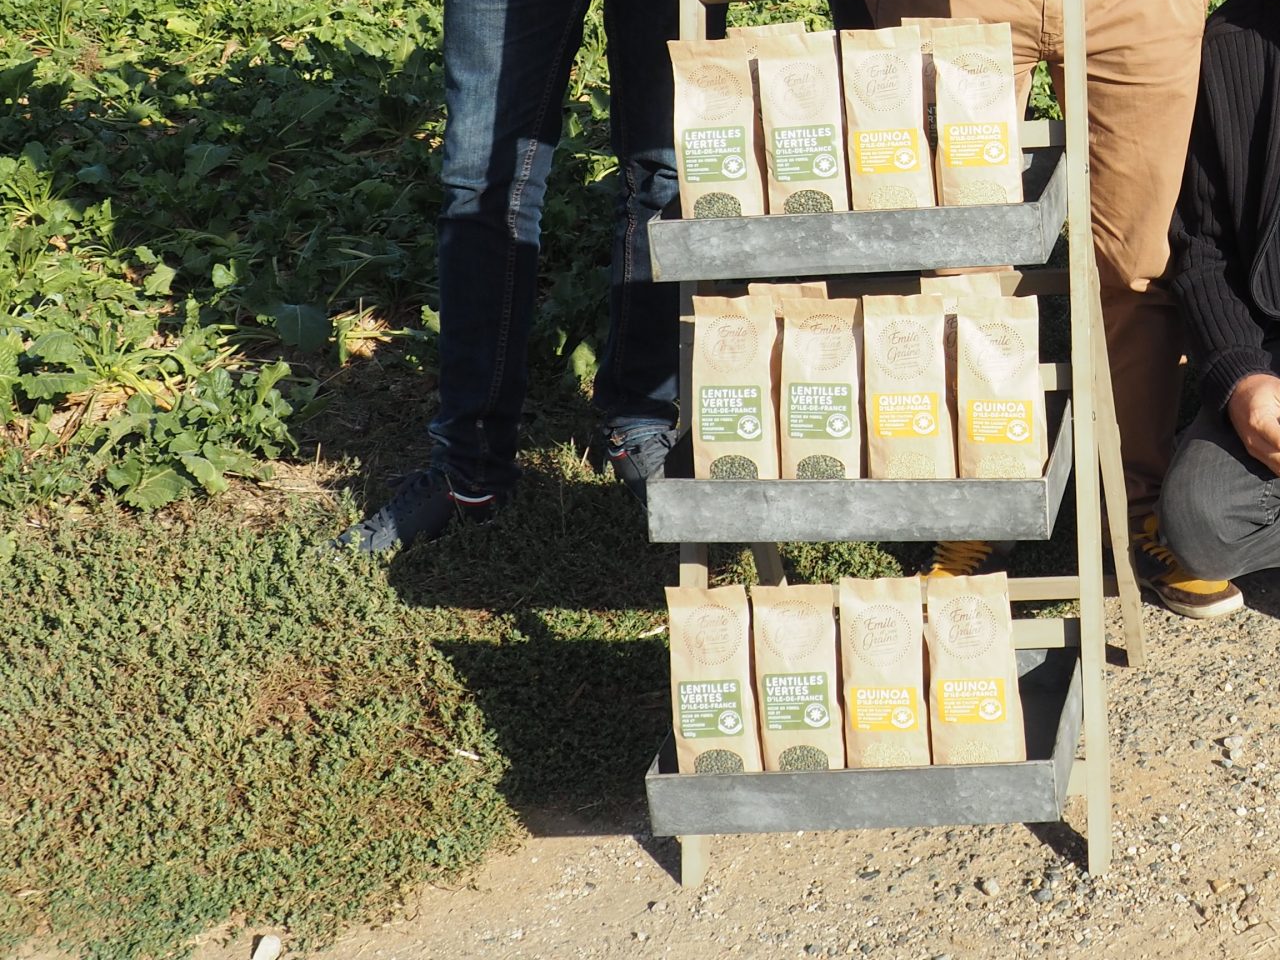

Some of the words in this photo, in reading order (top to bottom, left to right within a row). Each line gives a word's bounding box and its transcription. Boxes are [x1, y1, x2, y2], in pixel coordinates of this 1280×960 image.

[685, 129, 741, 140] LENTILLES
[775, 127, 831, 140] LENTILLES
[950, 125, 1001, 136] QUINOA
[860, 131, 911, 142] QUINOA
[685, 139, 727, 149] VERTES
[775, 138, 817, 149] VERTES
[702, 388, 757, 398] LENTILLES
[791, 386, 848, 396] LENTILLES
[702, 398, 743, 407] VERTES
[791, 396, 832, 405] VERTES
[879, 395, 930, 406] QUINOA
[973, 402, 1025, 413] QUINOA
[766, 676, 823, 686] LENTILLES
[943, 681, 997, 692] QUINOA
[680, 683, 736, 694] LENTILLES
[767, 686, 809, 695] VERTES
[681, 693, 722, 703] VERTES
[857, 689, 910, 700] QUINOA
